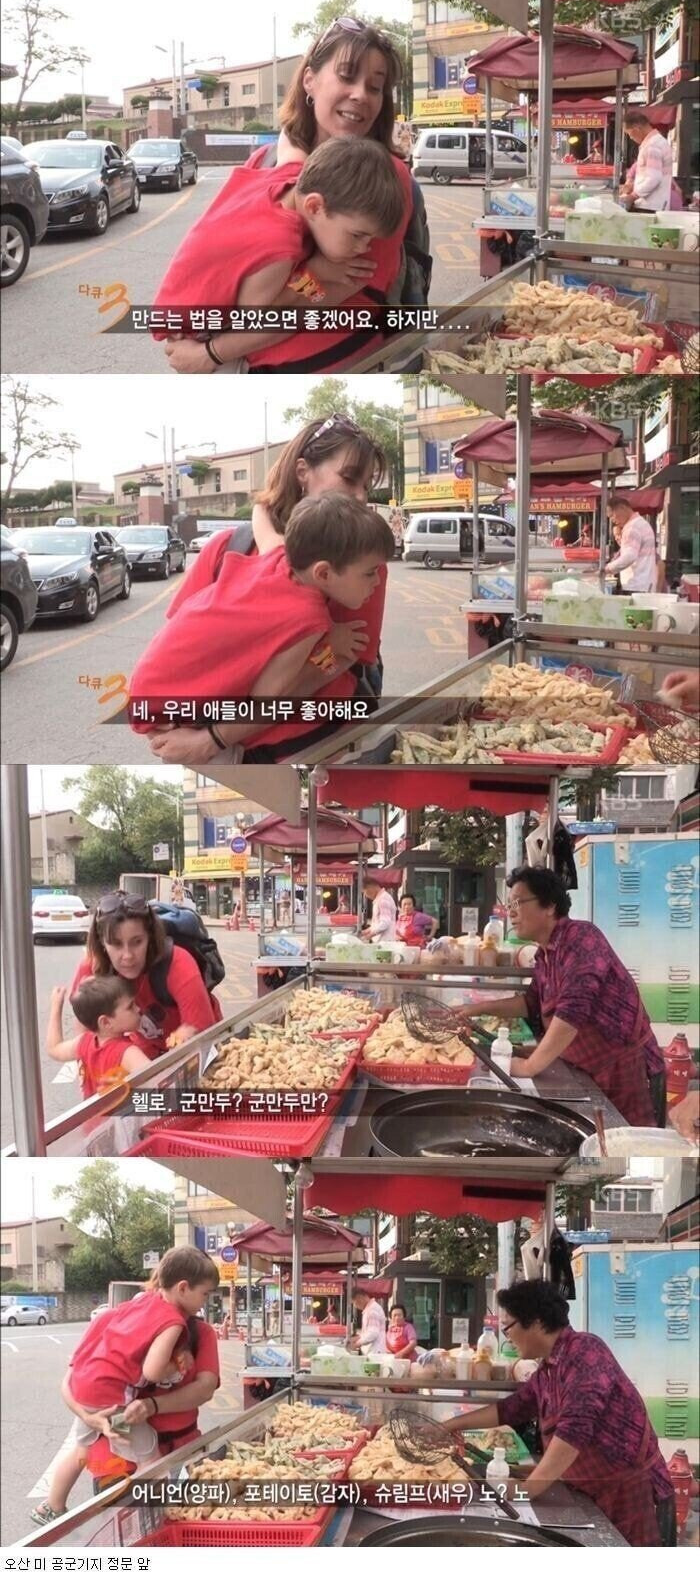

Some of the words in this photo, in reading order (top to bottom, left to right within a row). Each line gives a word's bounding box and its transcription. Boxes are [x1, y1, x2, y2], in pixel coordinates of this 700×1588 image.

[421, 100, 444, 110] Kodak
[557, 118, 602, 126] HAMBURGER
[412, 485, 435, 494] Kodak
[546, 502, 591, 510] HAMBURGER
[191, 858, 214, 867] Kodak
